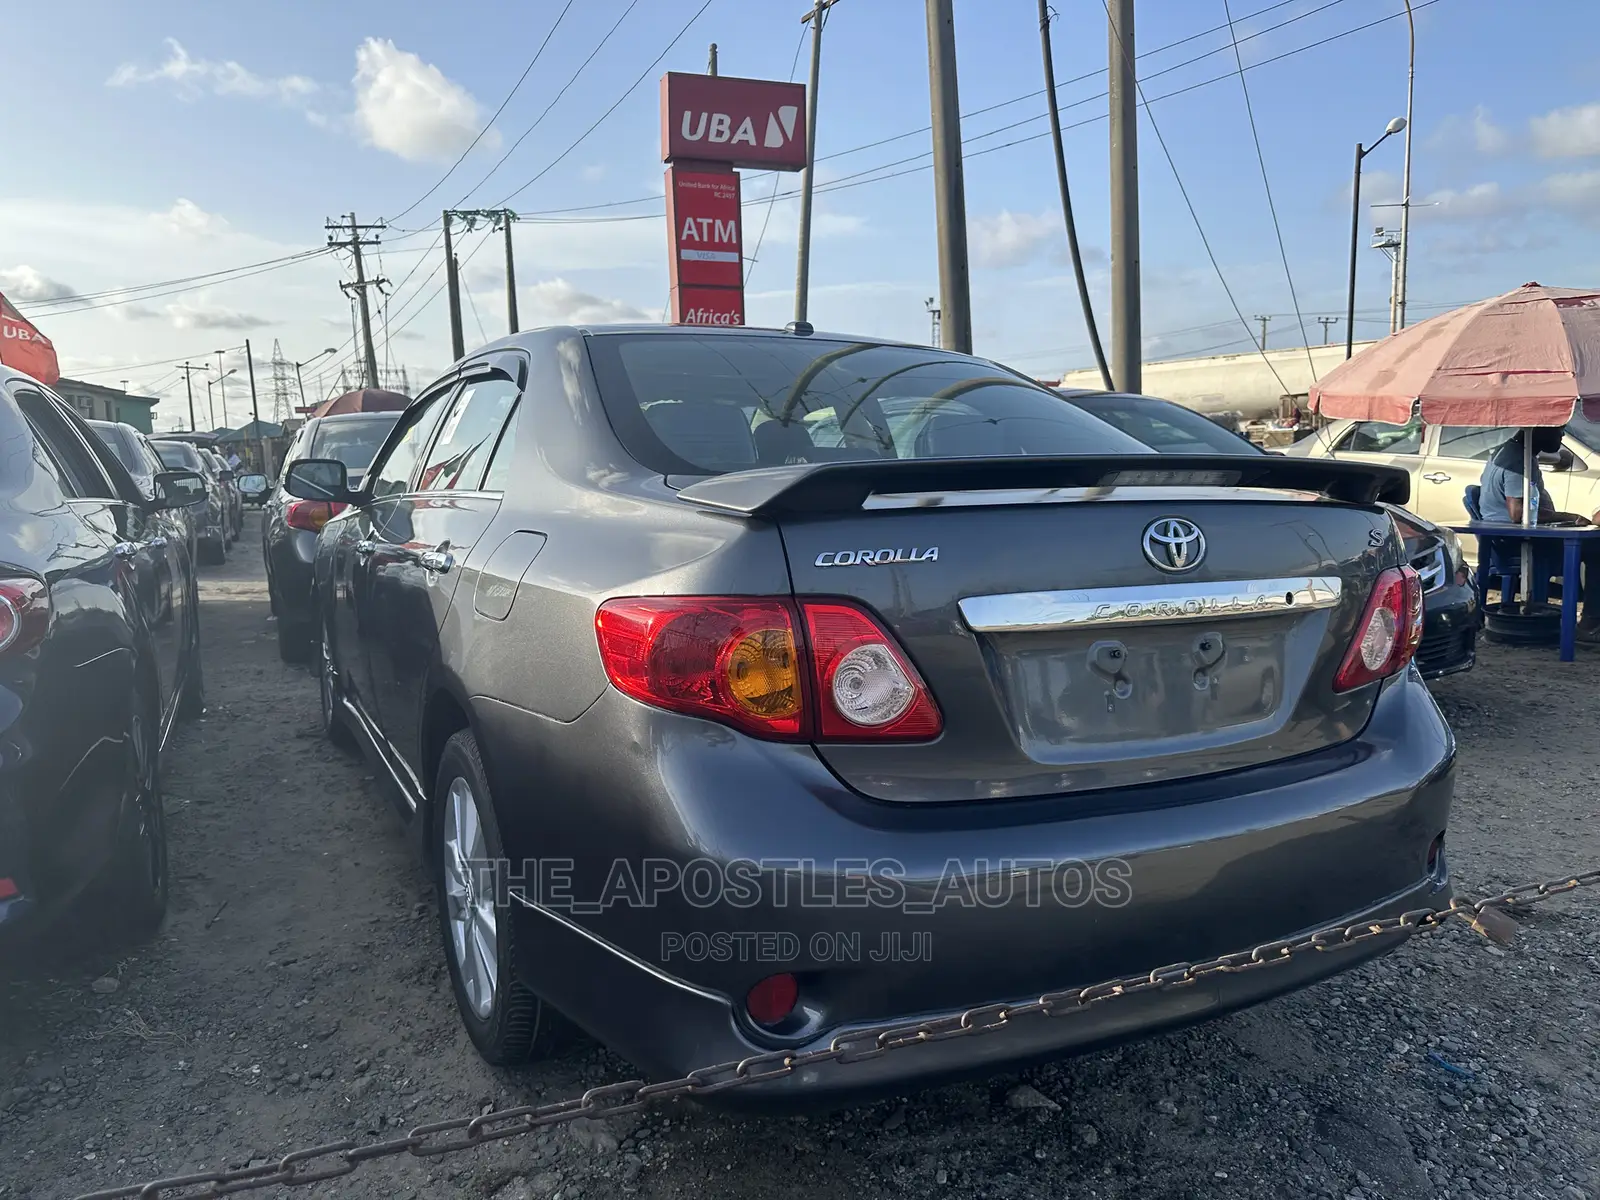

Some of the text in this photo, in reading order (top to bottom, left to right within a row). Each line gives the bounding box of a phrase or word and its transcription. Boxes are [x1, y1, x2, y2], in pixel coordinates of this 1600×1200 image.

[681, 110, 757, 146] UBA
[678, 180, 697, 188] United
[697, 181, 711, 189] Bank
[681, 217, 737, 244] ATM
[684, 307, 741, 325] Africa's
[3, 325, 47, 345] UBA
[1368, 528, 1385, 547] S
[813, 546, 939, 567] COROLLA
[1094, 594, 1269, 619] COROLLA
